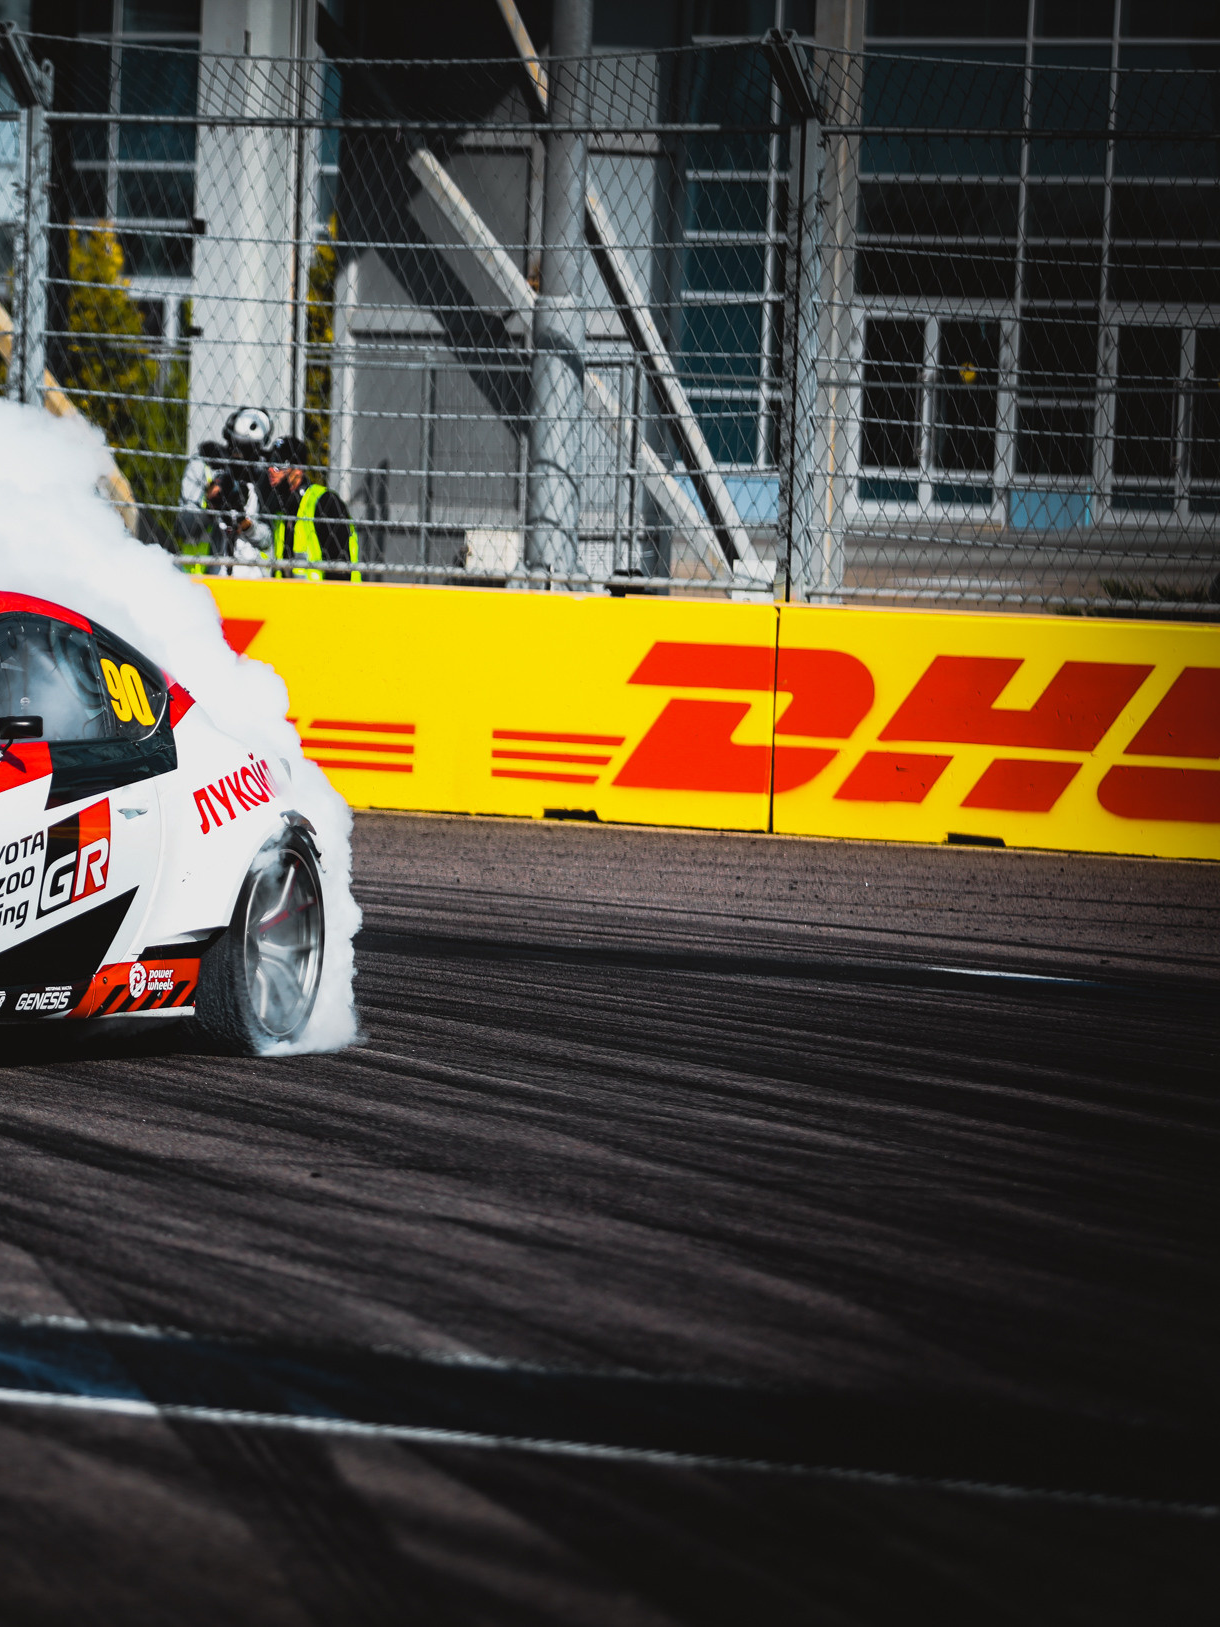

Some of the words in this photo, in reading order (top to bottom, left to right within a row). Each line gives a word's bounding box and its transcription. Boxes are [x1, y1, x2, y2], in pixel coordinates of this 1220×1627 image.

[100, 658, 156, 726] 90
[40, 837, 110, 911] GR
[147, 979, 174, 990] wheels
[149, 969, 174, 981] power
[15, 991, 70, 1011] GENESIS
